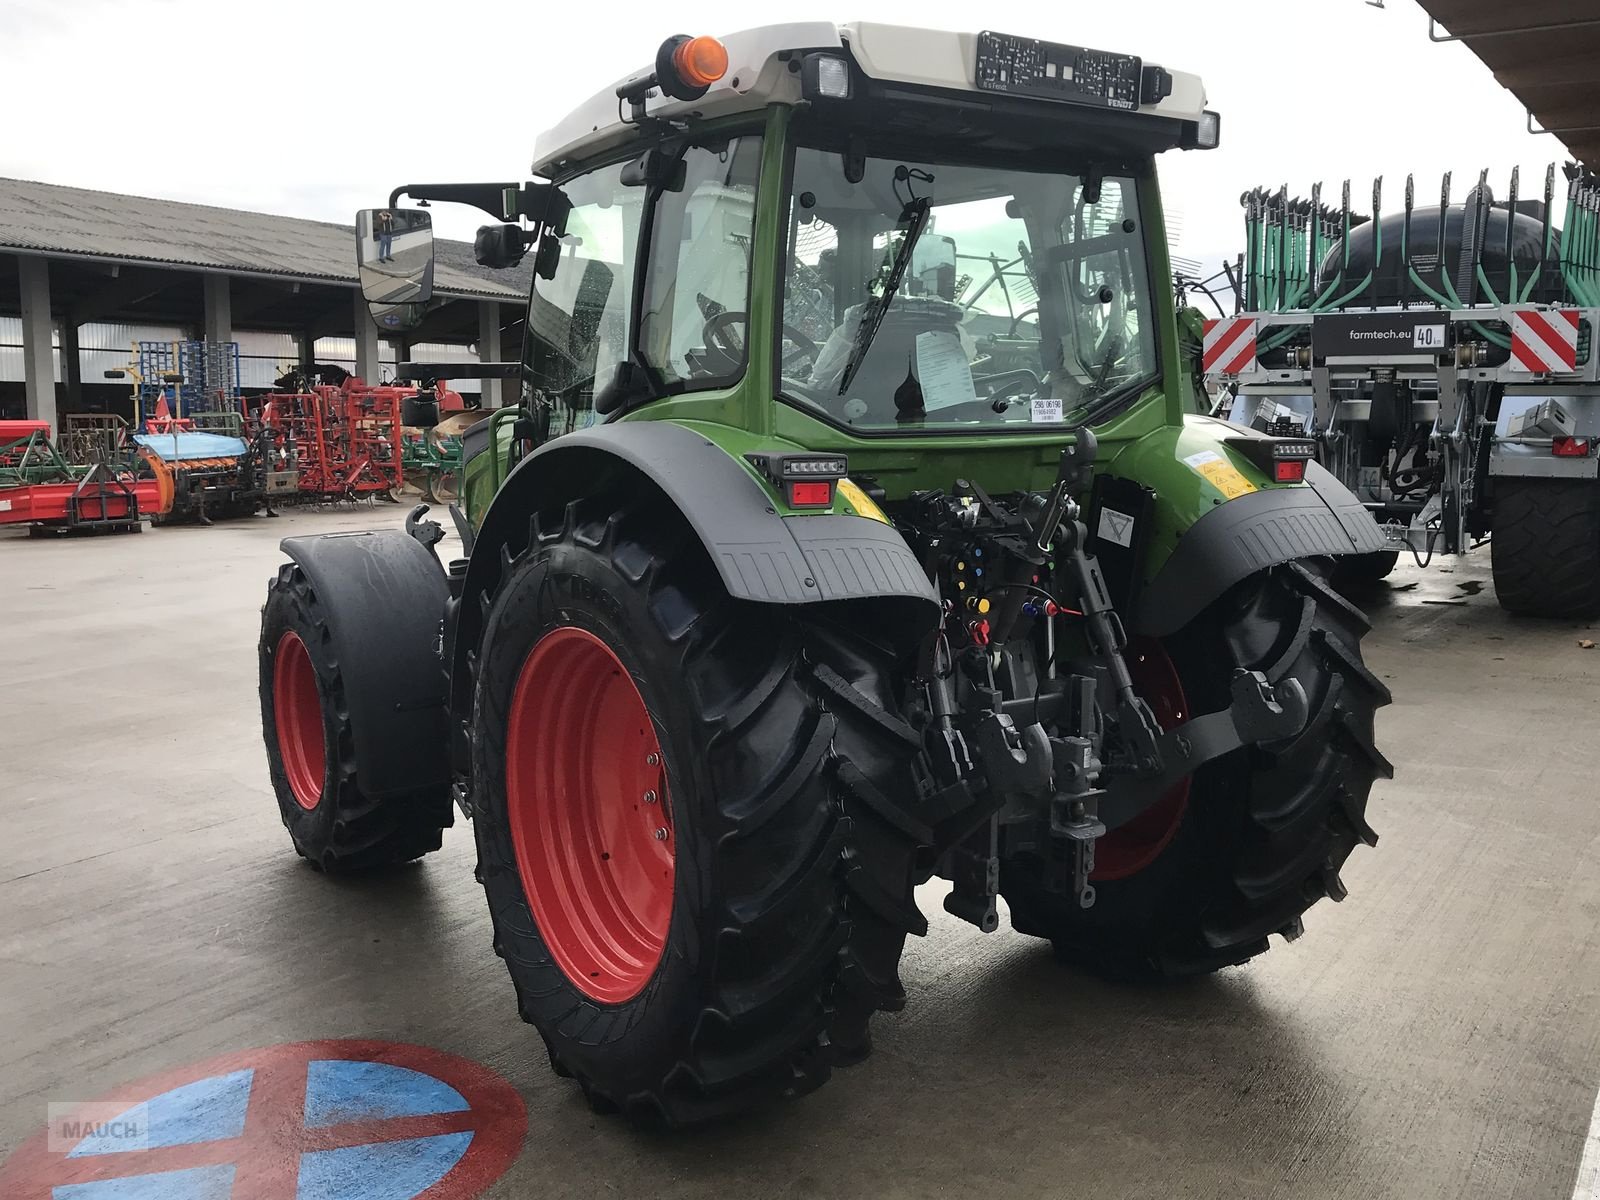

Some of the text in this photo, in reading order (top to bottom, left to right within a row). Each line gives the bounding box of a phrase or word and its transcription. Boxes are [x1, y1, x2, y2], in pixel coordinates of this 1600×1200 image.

[1107, 98, 1134, 109] FENDT
[1349, 329, 1411, 340] farmtech.eu
[1417, 327, 1433, 346] 40
